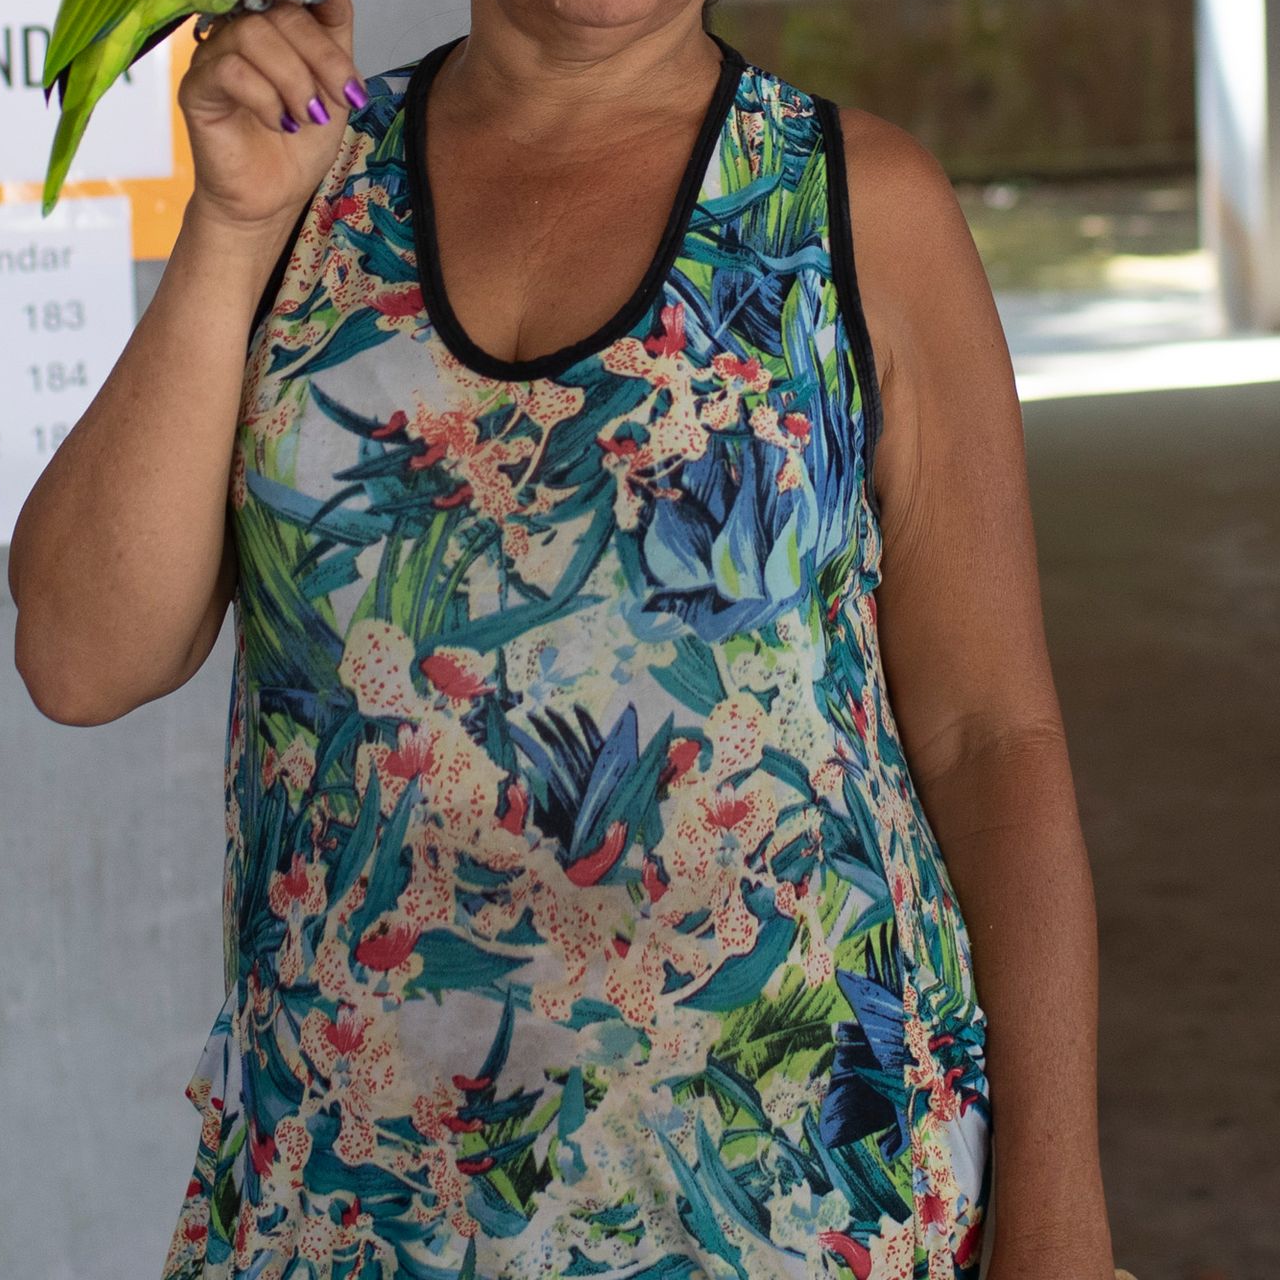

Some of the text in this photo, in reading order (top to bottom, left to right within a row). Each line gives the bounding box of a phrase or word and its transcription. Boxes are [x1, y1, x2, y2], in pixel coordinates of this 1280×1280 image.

[23, 300, 85, 333] 183
[26, 361, 88, 393] 184
[33, 422, 69, 454] 18
